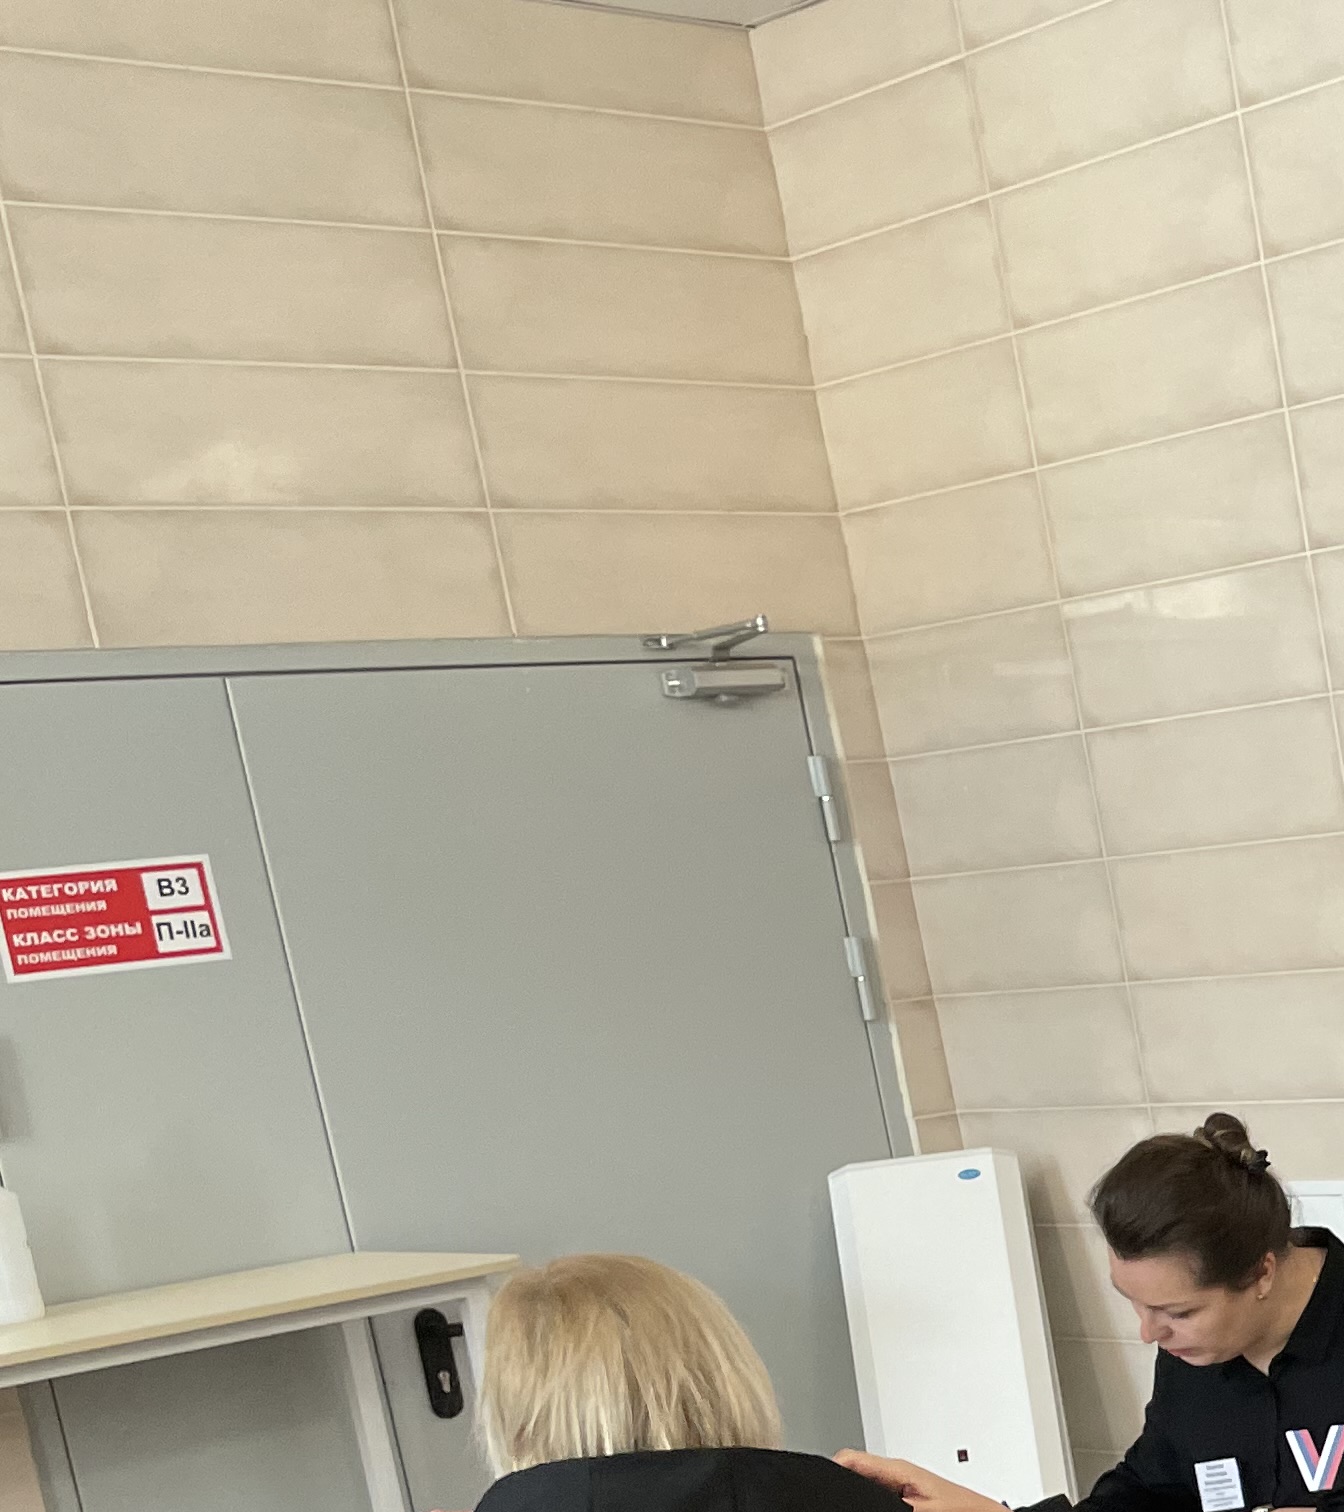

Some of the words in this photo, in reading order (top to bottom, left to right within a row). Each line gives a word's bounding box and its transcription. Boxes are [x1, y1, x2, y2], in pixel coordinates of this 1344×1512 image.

[1, 878, 118, 902] КАТЕГОРИЯ
[12, 928, 79, 948] КЛАСС
[84, 921, 142, 940] ЗОНЫ
